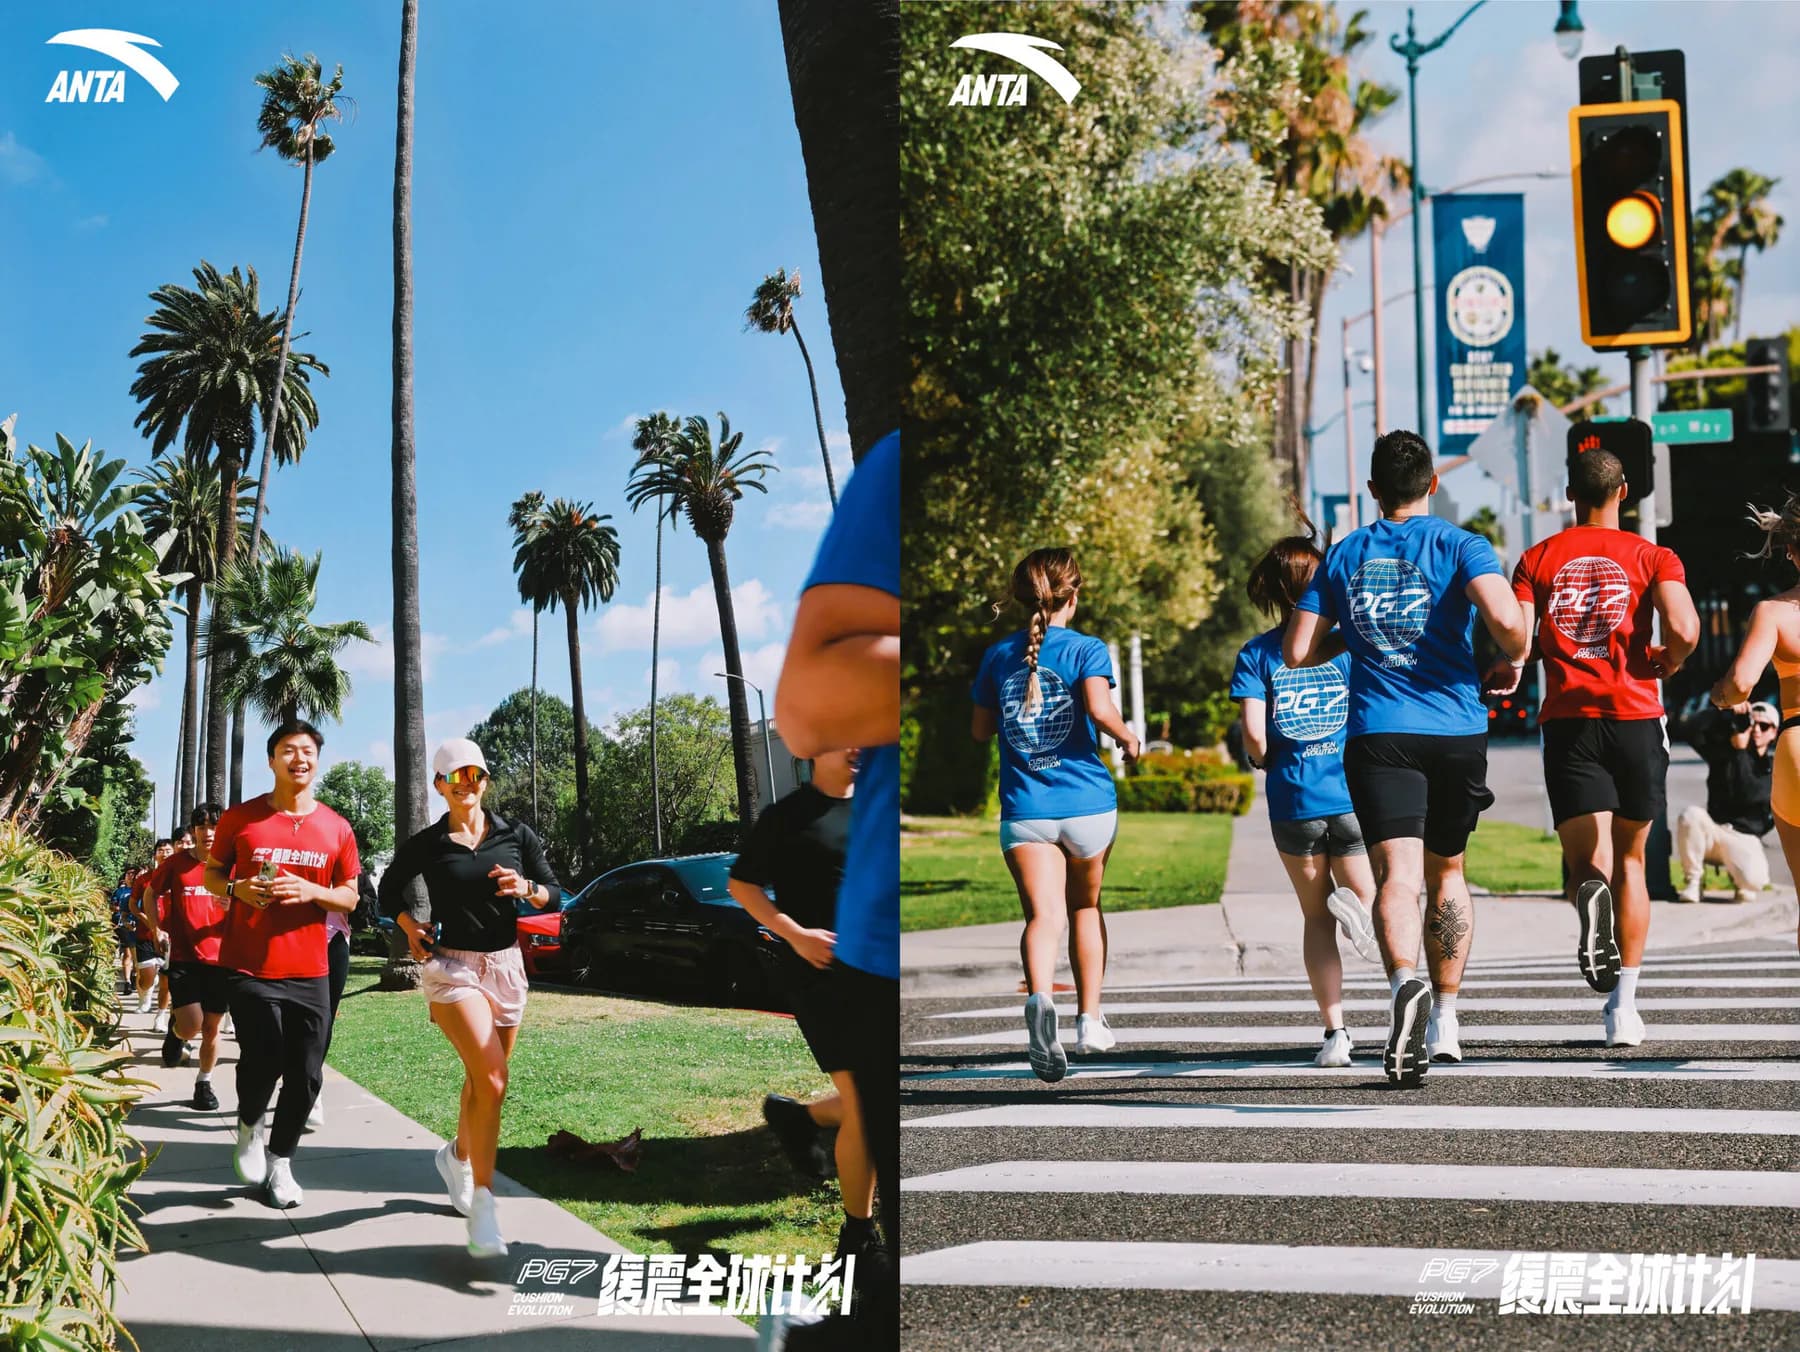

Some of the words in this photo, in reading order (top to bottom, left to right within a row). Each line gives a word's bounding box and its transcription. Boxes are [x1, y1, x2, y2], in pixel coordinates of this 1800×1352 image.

[1350, 588, 1432, 620] PG7
[1548, 584, 1631, 613] PG7
[1272, 685, 1349, 718] PG7
